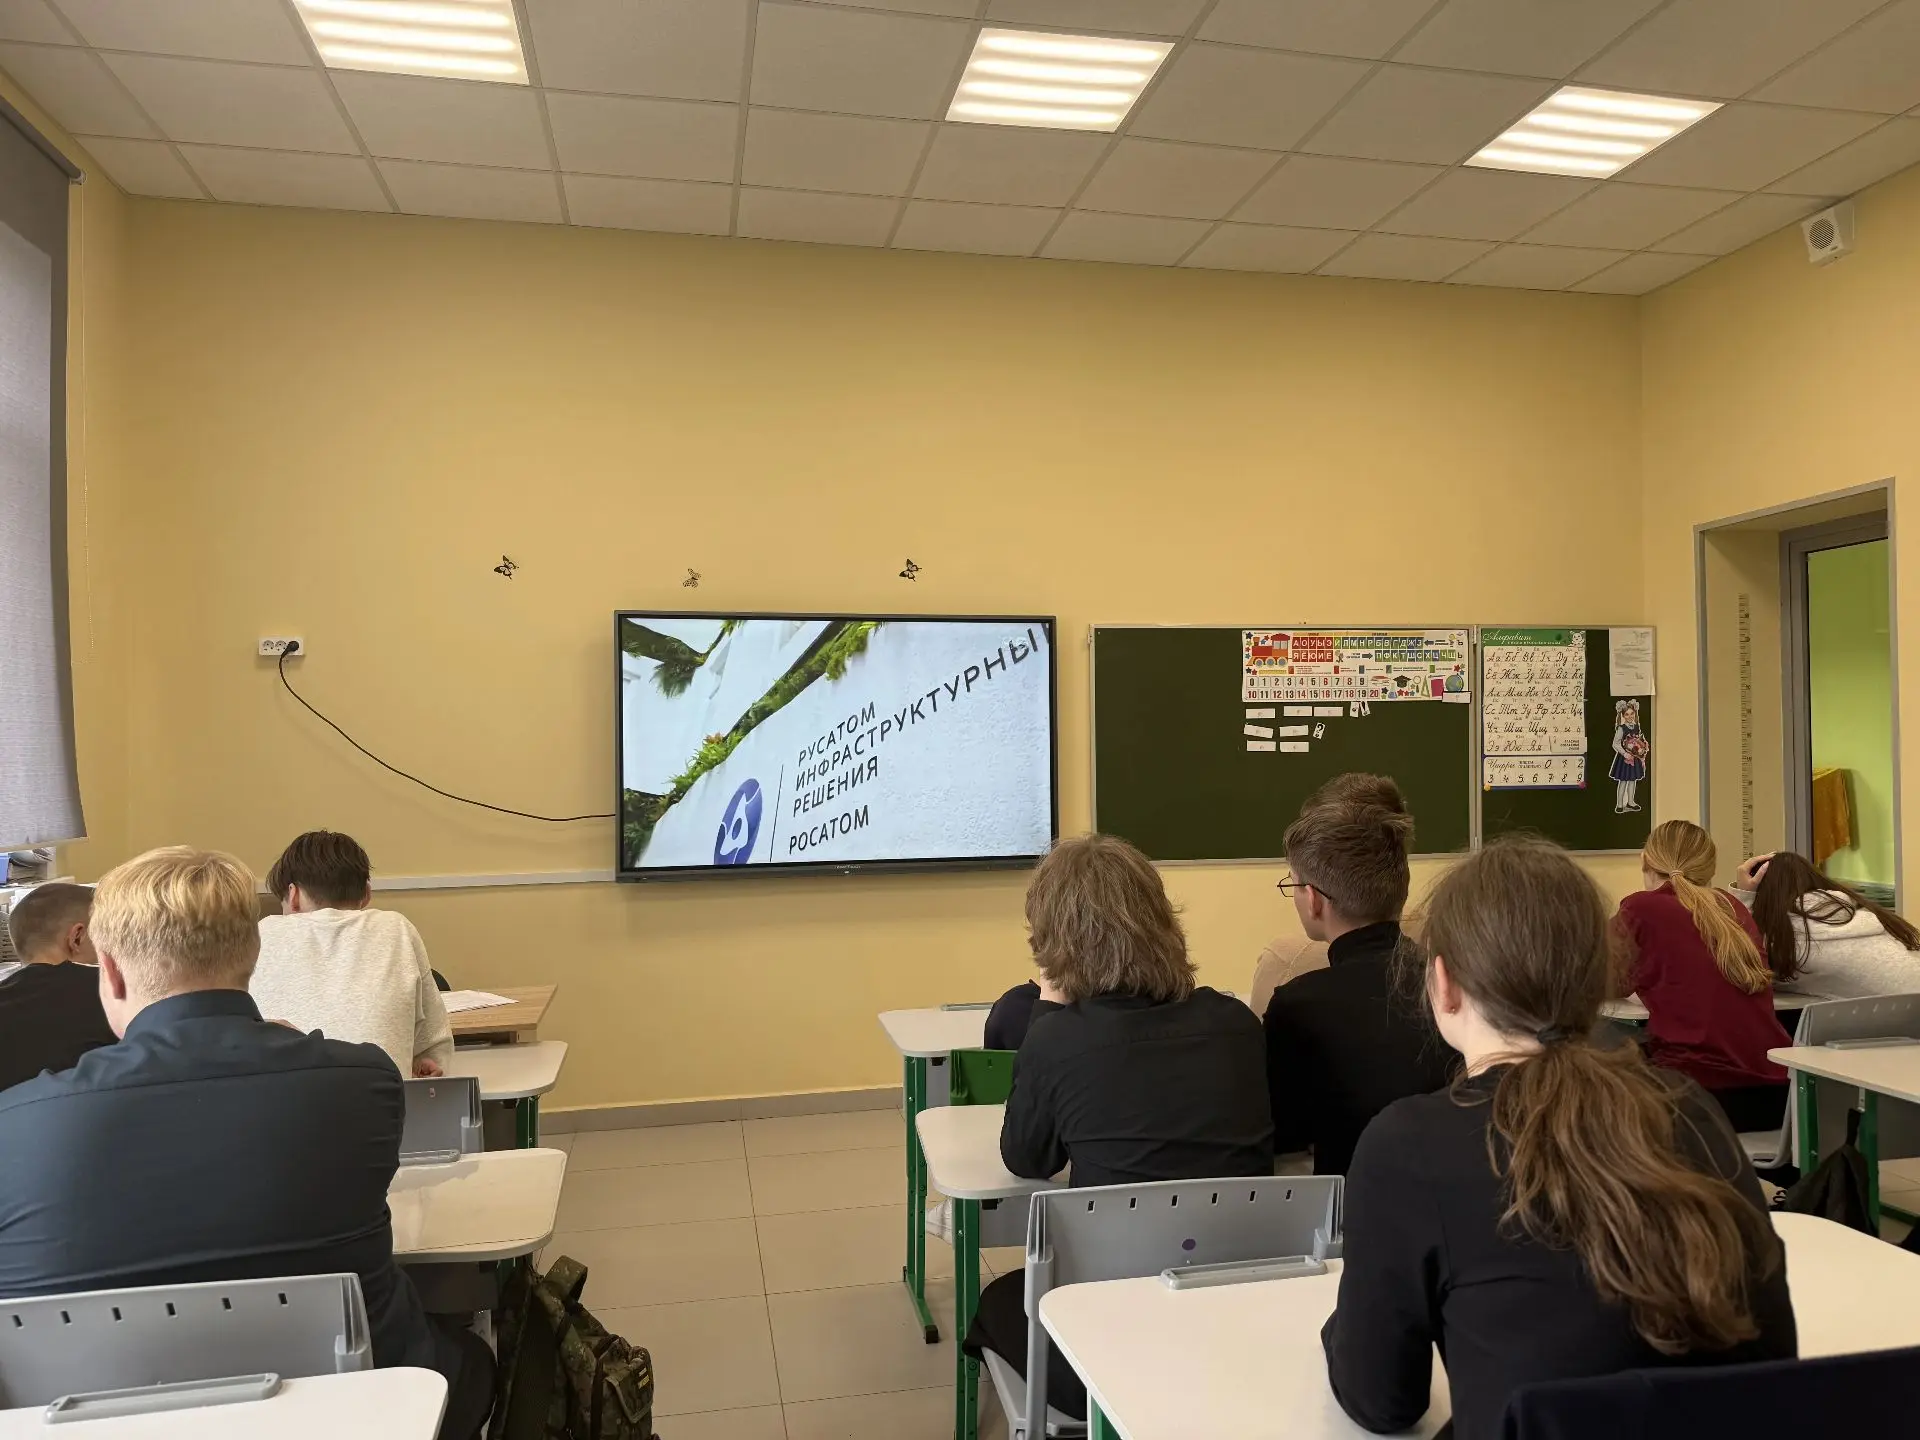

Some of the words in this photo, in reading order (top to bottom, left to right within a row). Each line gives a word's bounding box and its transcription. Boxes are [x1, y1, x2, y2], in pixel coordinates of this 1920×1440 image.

[1482, 630, 1532, 644] Алфавит
[1248, 690, 1257, 699] 10
[1260, 690, 1269, 699] 11
[1273, 690, 1282, 699] 12
[1285, 690, 1294, 699] 13
[1297, 690, 1307, 699] 14
[1309, 690, 1318, 699] 15
[1321, 690, 1330, 699] 16
[1334, 690, 1342, 699] 17
[1345, 690, 1354, 699] 18
[1357, 690, 1367, 699] 19
[1369, 690, 1379, 699] 20
[798, 701, 876, 767] РУСАТОМ
[793, 755, 879, 818] РЕШЕНИЯ
[789, 804, 869, 855] РОСАТОМ
